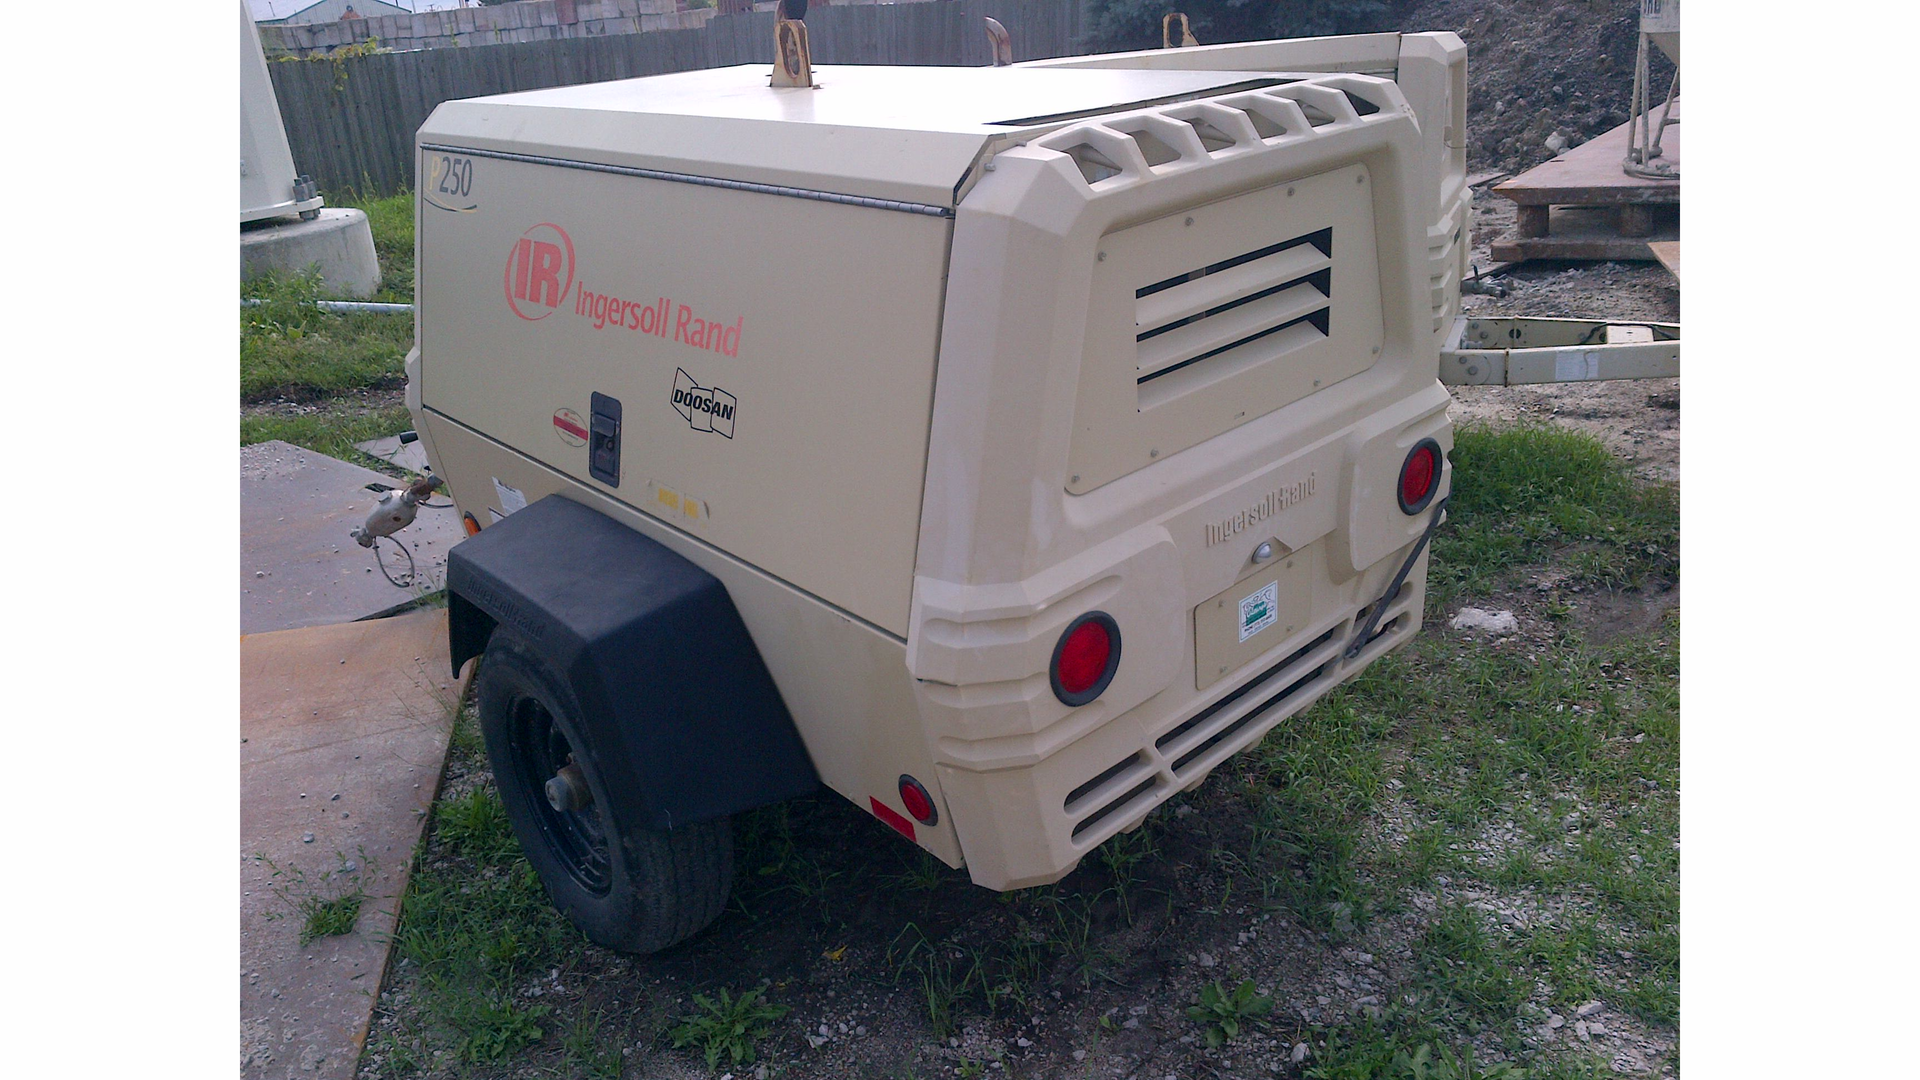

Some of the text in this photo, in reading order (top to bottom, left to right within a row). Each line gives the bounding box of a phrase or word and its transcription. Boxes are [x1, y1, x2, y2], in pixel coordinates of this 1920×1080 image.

[428, 155, 473, 197] P250
[514, 237, 562, 309] IR
[574, 280, 744, 358] Ingersoll Rand
[673, 388, 734, 421] DOOSAN
